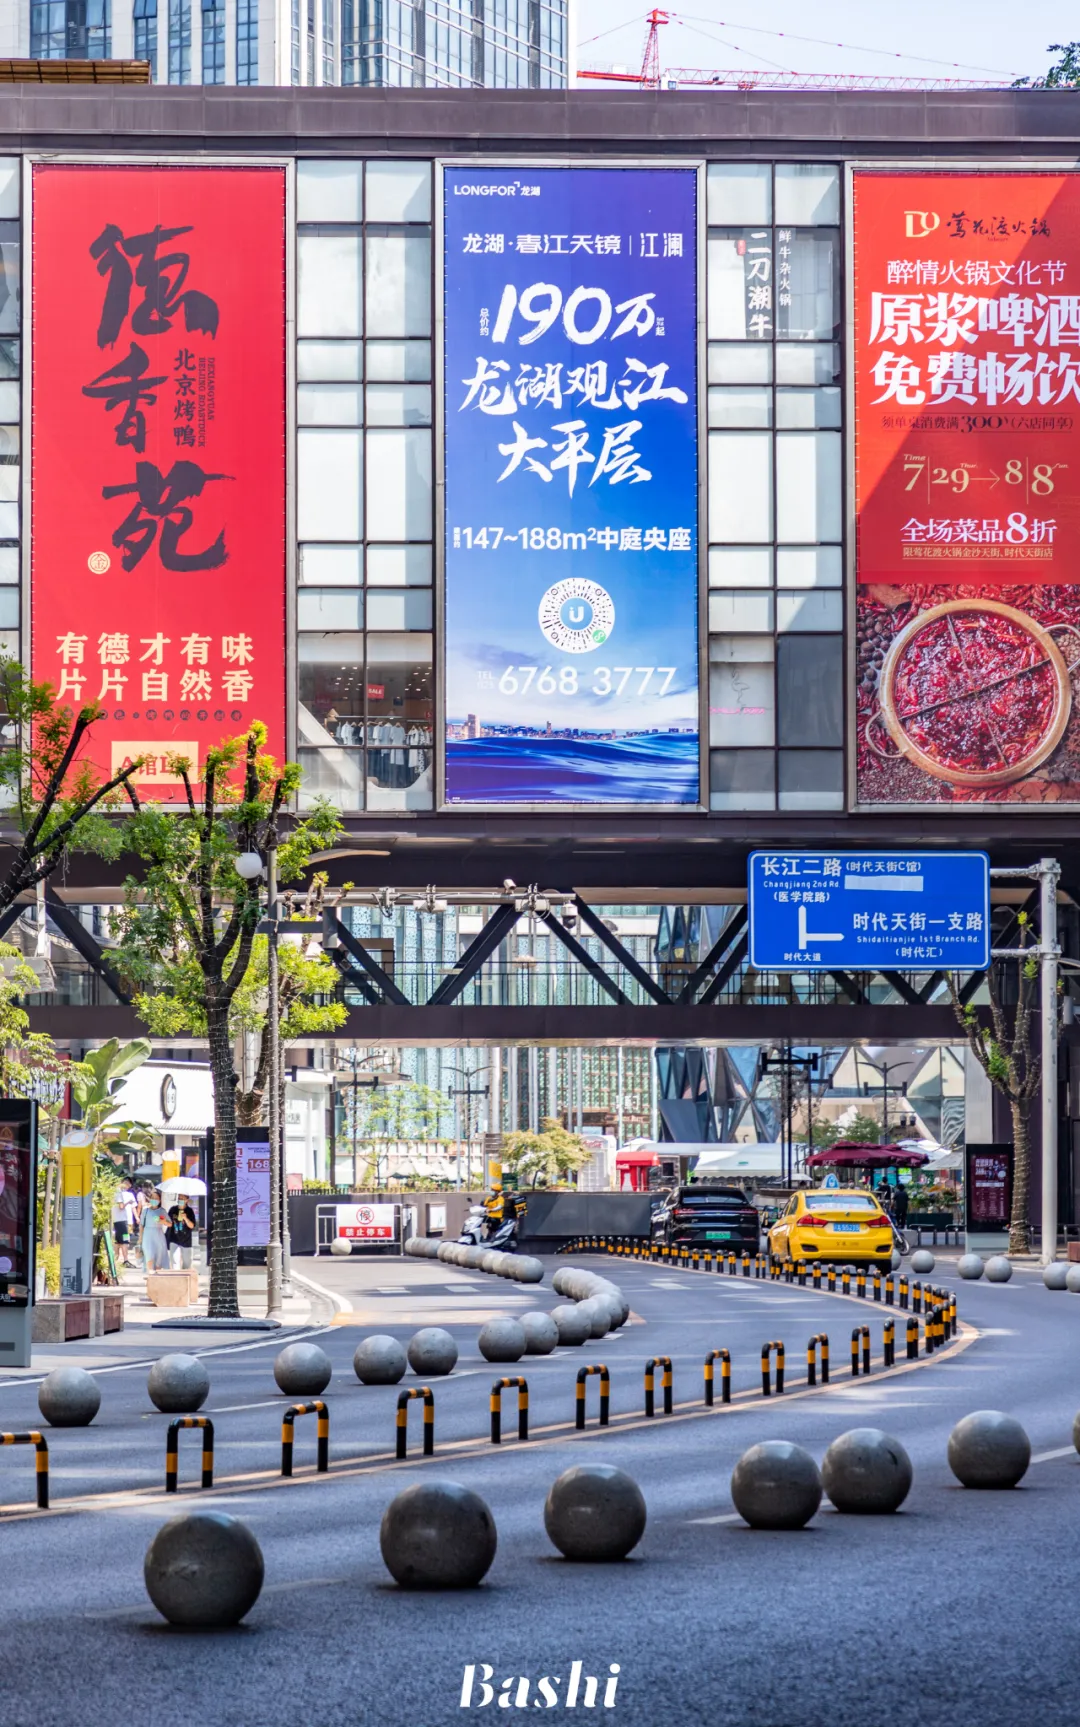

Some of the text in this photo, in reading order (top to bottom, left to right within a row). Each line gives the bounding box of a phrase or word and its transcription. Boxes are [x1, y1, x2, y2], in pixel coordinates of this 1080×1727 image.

[454, 185, 540, 196] LONGFOR 龙湖
[640, 232, 683, 257] 江澜
[779, 230, 791, 306] 鲜牛杂火锅
[887, 260, 1067, 285] 醉情火锅文化节
[747, 232, 773, 338] 二刀潮牛
[868, 292, 1080, 346] 原浆啤酒
[458, 356, 688, 415] 龙湖观江
[869, 351, 1080, 405] 免费畅饮
[496, 420, 652, 499] 大平层
[904, 460, 1054, 495] 7 29 8 8
[900, 512, 1057, 543] 全场菜品8折
[56, 632, 255, 665] 有德才有味
[55, 669, 254, 702] 片片自然香
[500, 665, 677, 695] 6768 3777
[761, 857, 921, 876] 长江二路 (时代天街C馆)
[763, 881, 811, 890] Changjiang
[773, 891, 830, 903] (医学院路)
[853, 912, 983, 931] 时代天街一支路
[857, 935, 980, 944] Shidaitianjie 1st Branch Rd.
[895, 946, 943, 958] (时代汇)
[784, 952, 822, 962] 时代大道
[345, 1227, 385, 1237] 禁止停车
